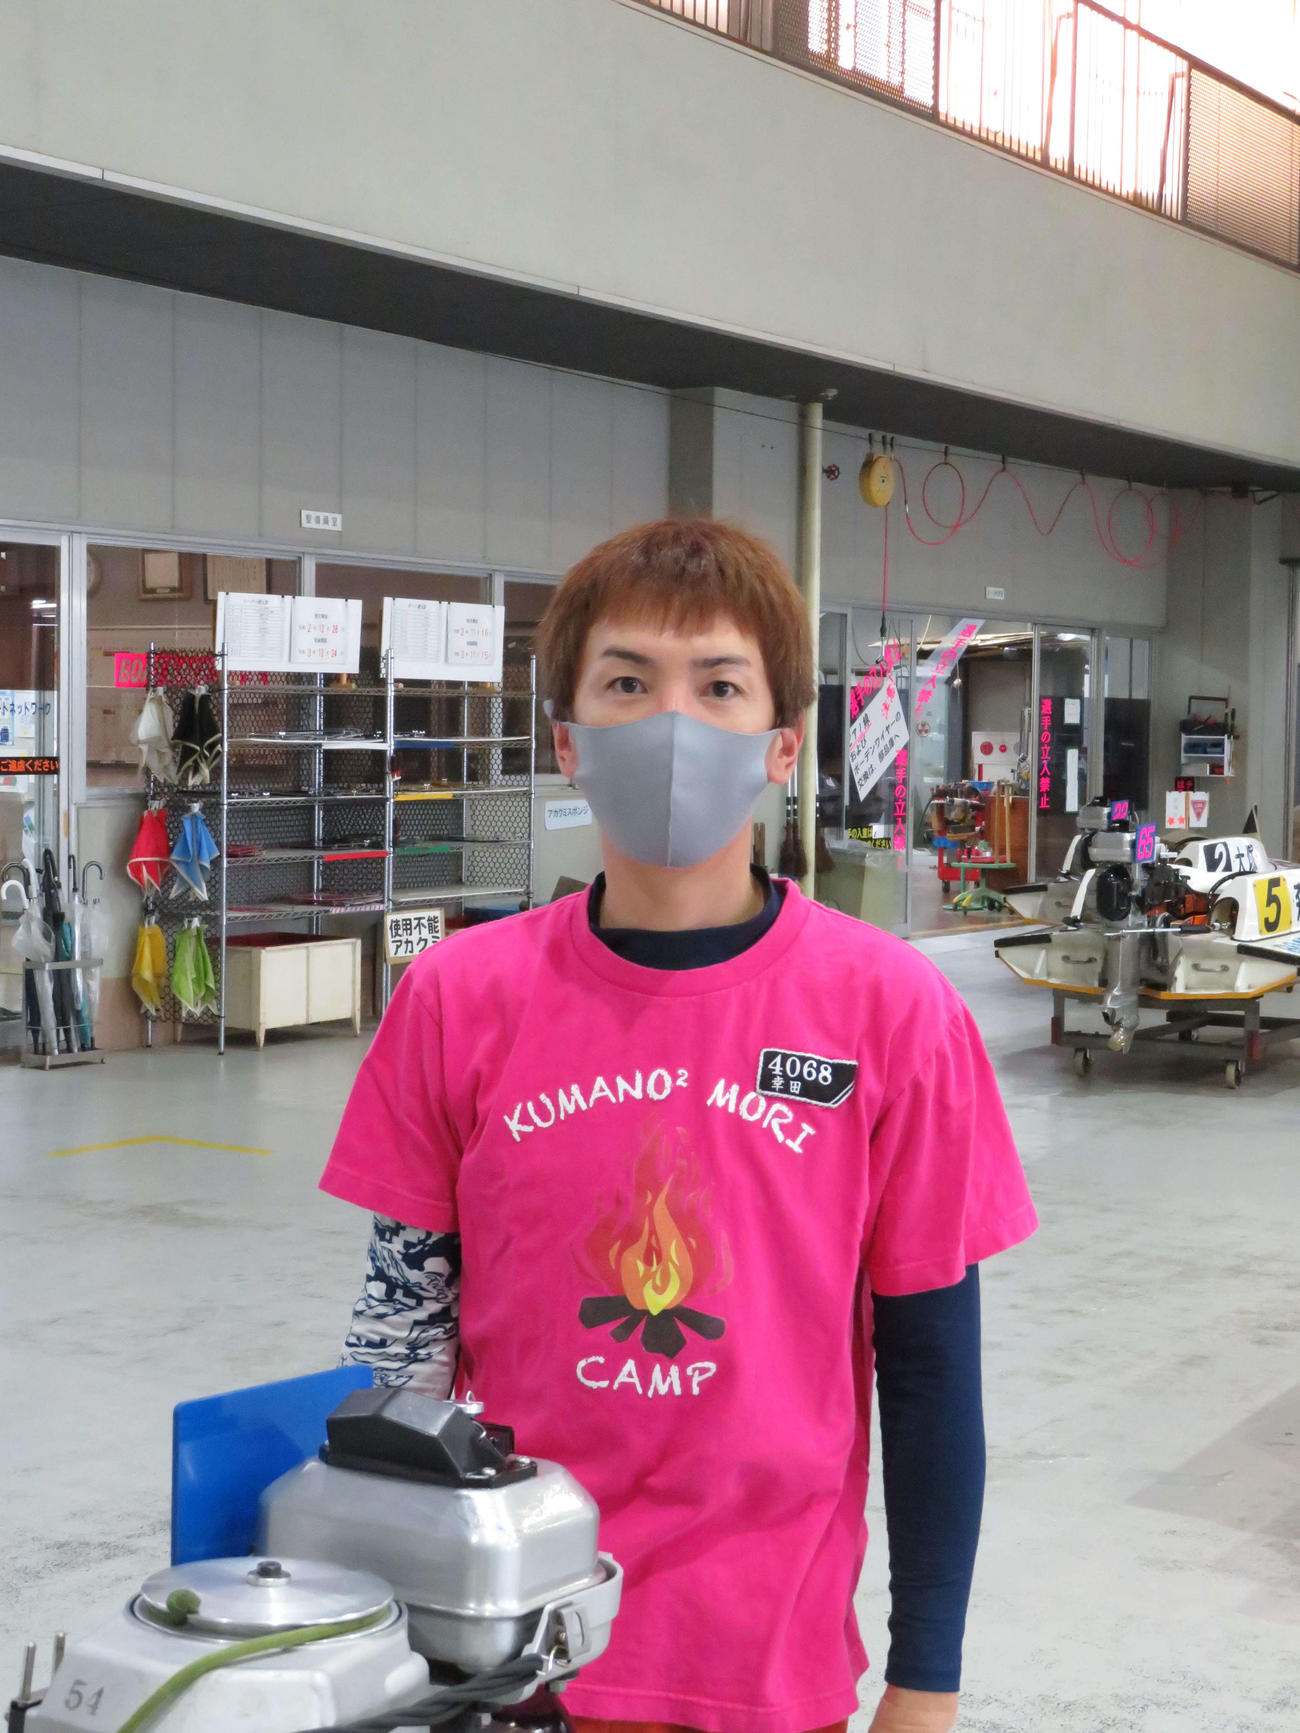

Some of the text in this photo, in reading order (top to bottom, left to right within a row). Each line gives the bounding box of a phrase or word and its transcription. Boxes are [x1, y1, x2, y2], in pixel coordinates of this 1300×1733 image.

[0, 702, 51, 716] トネットワーク
[1039, 698, 1052, 809] 選手の立入禁止
[894, 749, 908, 851] 選手の立入禁
[1136, 825, 1156, 861] 65
[1214, 843, 1227, 872] 2
[1264, 877, 1282, 933] 5
[389, 915, 440, 938] 使用不能
[768, 1054, 832, 1085] 4068
[771, 1076, 801, 1094] 幸田
[706, 1078, 816, 1153] MORI
[576, 1355, 717, 1398] CAMP
[64, 1680, 104, 1716] 54
